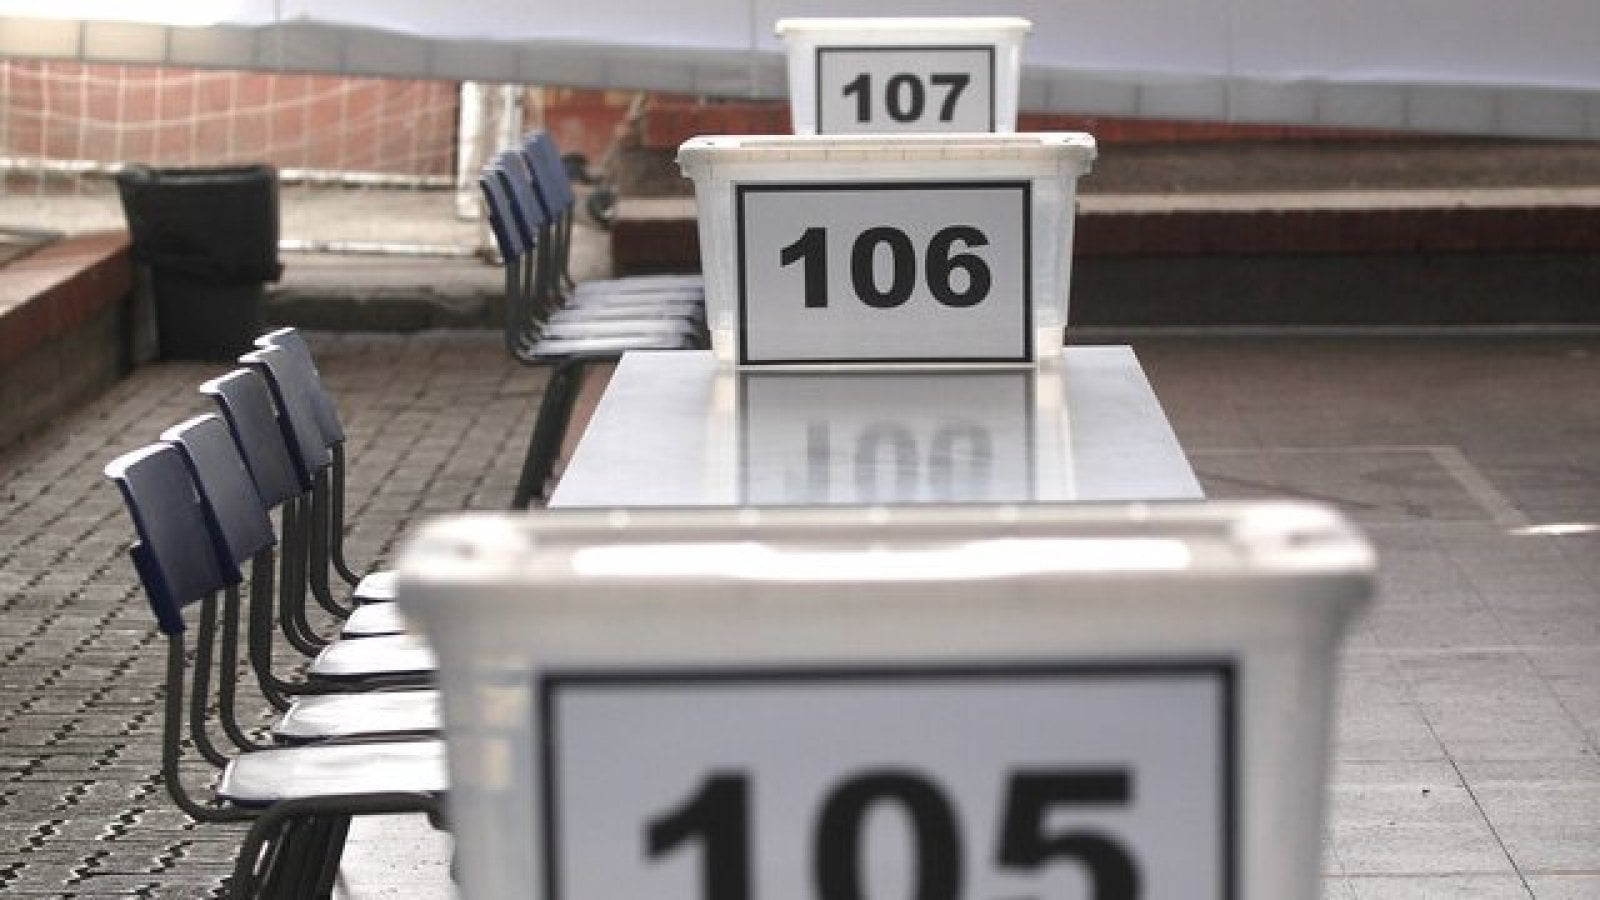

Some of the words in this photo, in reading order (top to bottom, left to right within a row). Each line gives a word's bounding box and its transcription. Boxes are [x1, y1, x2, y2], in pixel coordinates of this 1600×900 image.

[842, 73, 971, 123] 107
[779, 225, 992, 309] 106
[643, 765, 1144, 900] 105
